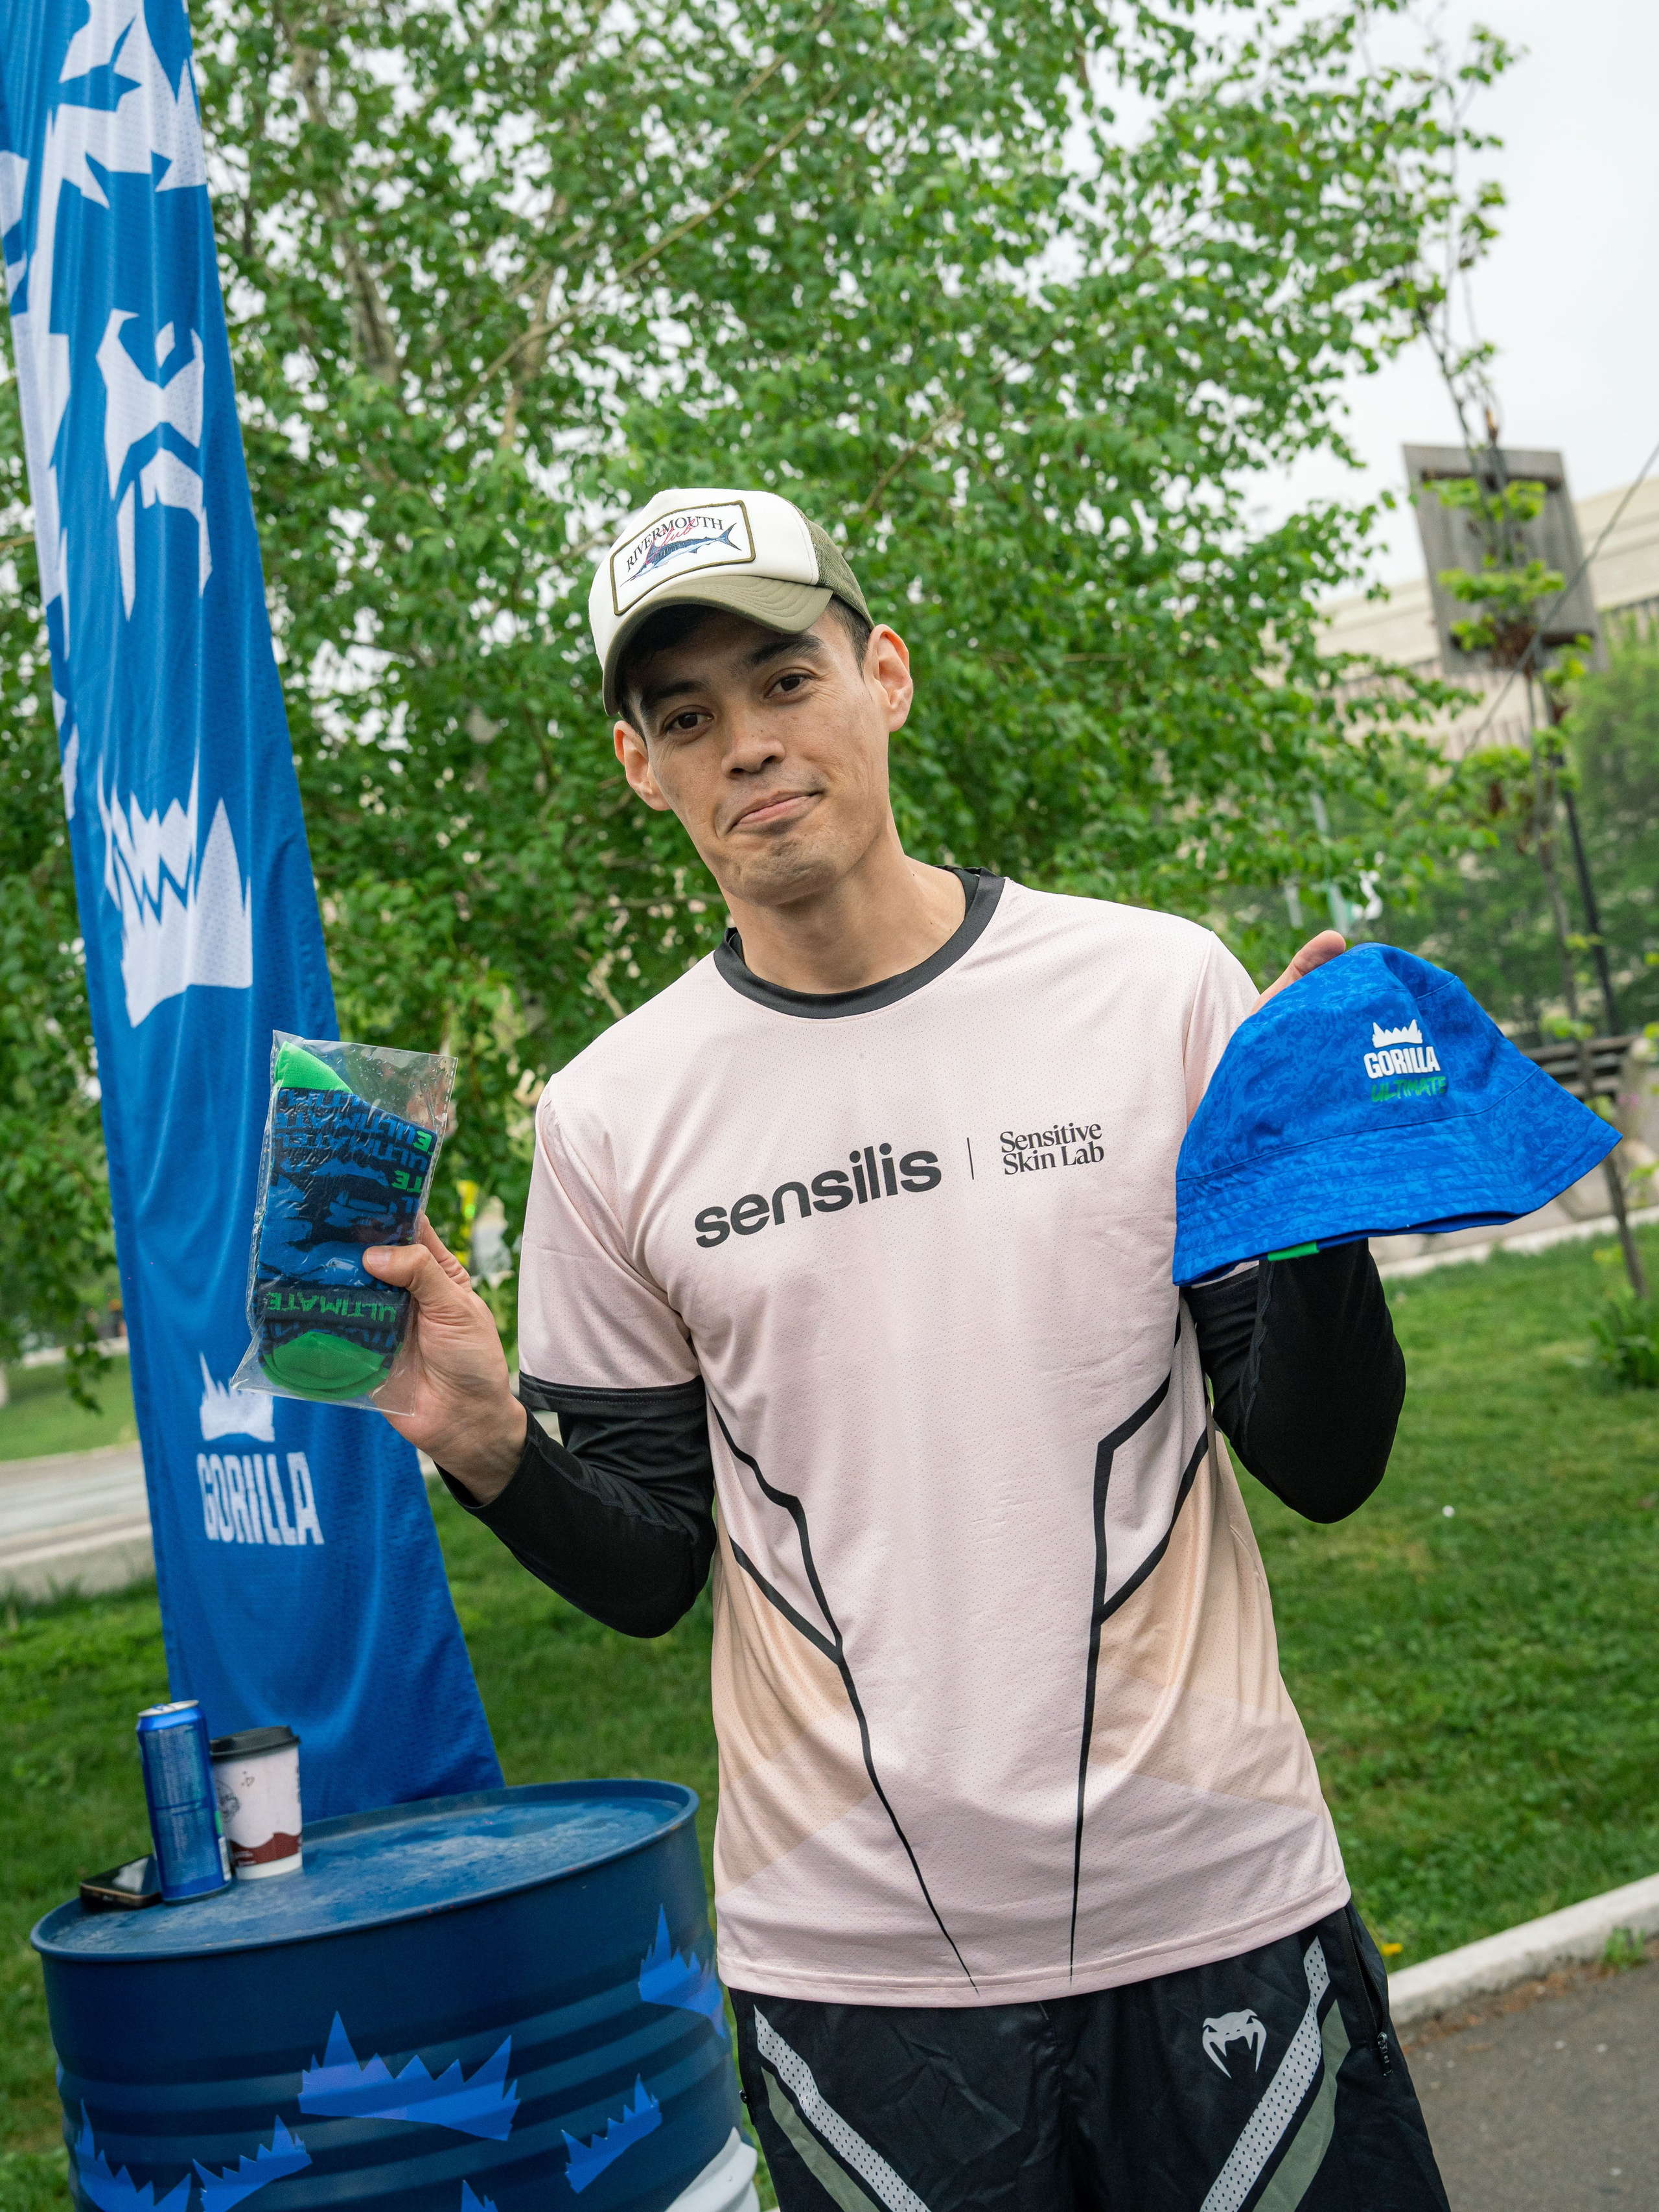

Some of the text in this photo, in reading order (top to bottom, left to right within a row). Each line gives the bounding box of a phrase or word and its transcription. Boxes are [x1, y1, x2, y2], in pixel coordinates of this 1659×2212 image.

[626, 516, 724, 572] RIVERMOUTH
[1363, 1046, 1441, 1079] GORILLA
[1371, 1076, 1447, 1102] ULTIMATE
[1003, 1141, 1104, 1175] Skin Lab
[695, 1123, 1102, 1248] sensilis Sensitive
[266, 1292, 397, 1323] ULTIMATE
[196, 1451, 324, 1546] GORILLA
